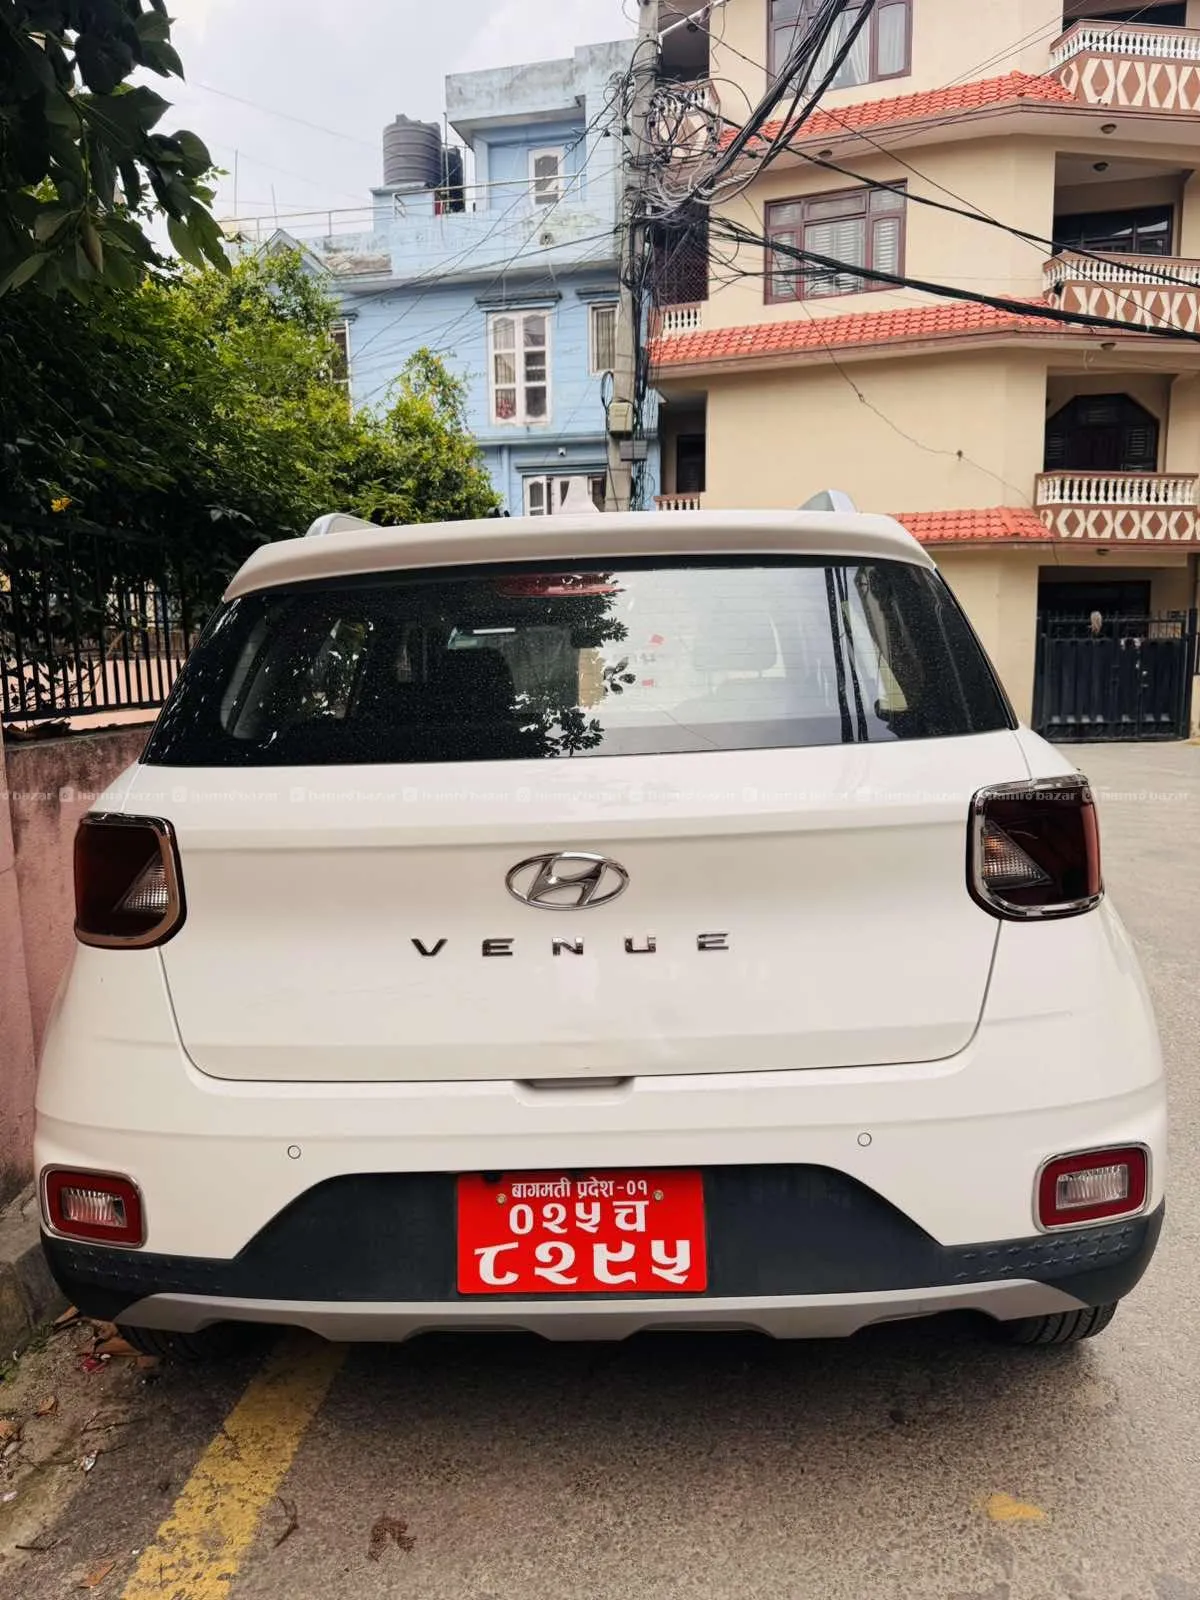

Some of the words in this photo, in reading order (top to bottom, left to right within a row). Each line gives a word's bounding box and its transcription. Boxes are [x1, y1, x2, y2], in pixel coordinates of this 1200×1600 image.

[411, 933, 729, 957] VENUE
[511, 1177, 571, 1199] बागमती
[508, 1201, 601, 1235] ०२५
[612, 1200, 649, 1233] च
